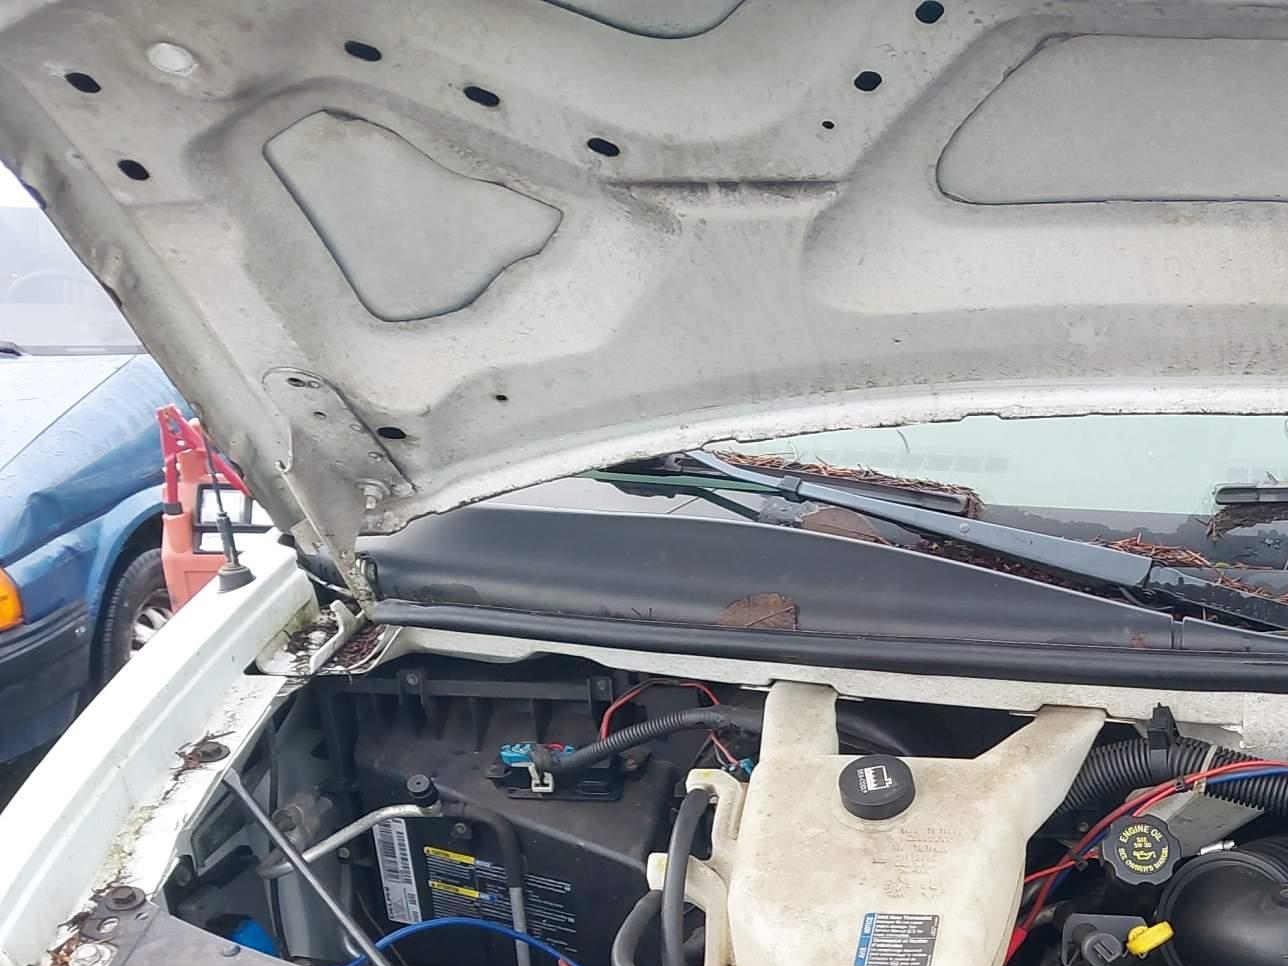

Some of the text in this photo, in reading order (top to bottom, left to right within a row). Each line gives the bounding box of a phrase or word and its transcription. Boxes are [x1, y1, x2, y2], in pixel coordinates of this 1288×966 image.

[1119, 824, 1163, 844] ENGINE OIL
[1118, 847, 1126, 861] SEE
[1154, 845, 1169, 869] MANUAL
